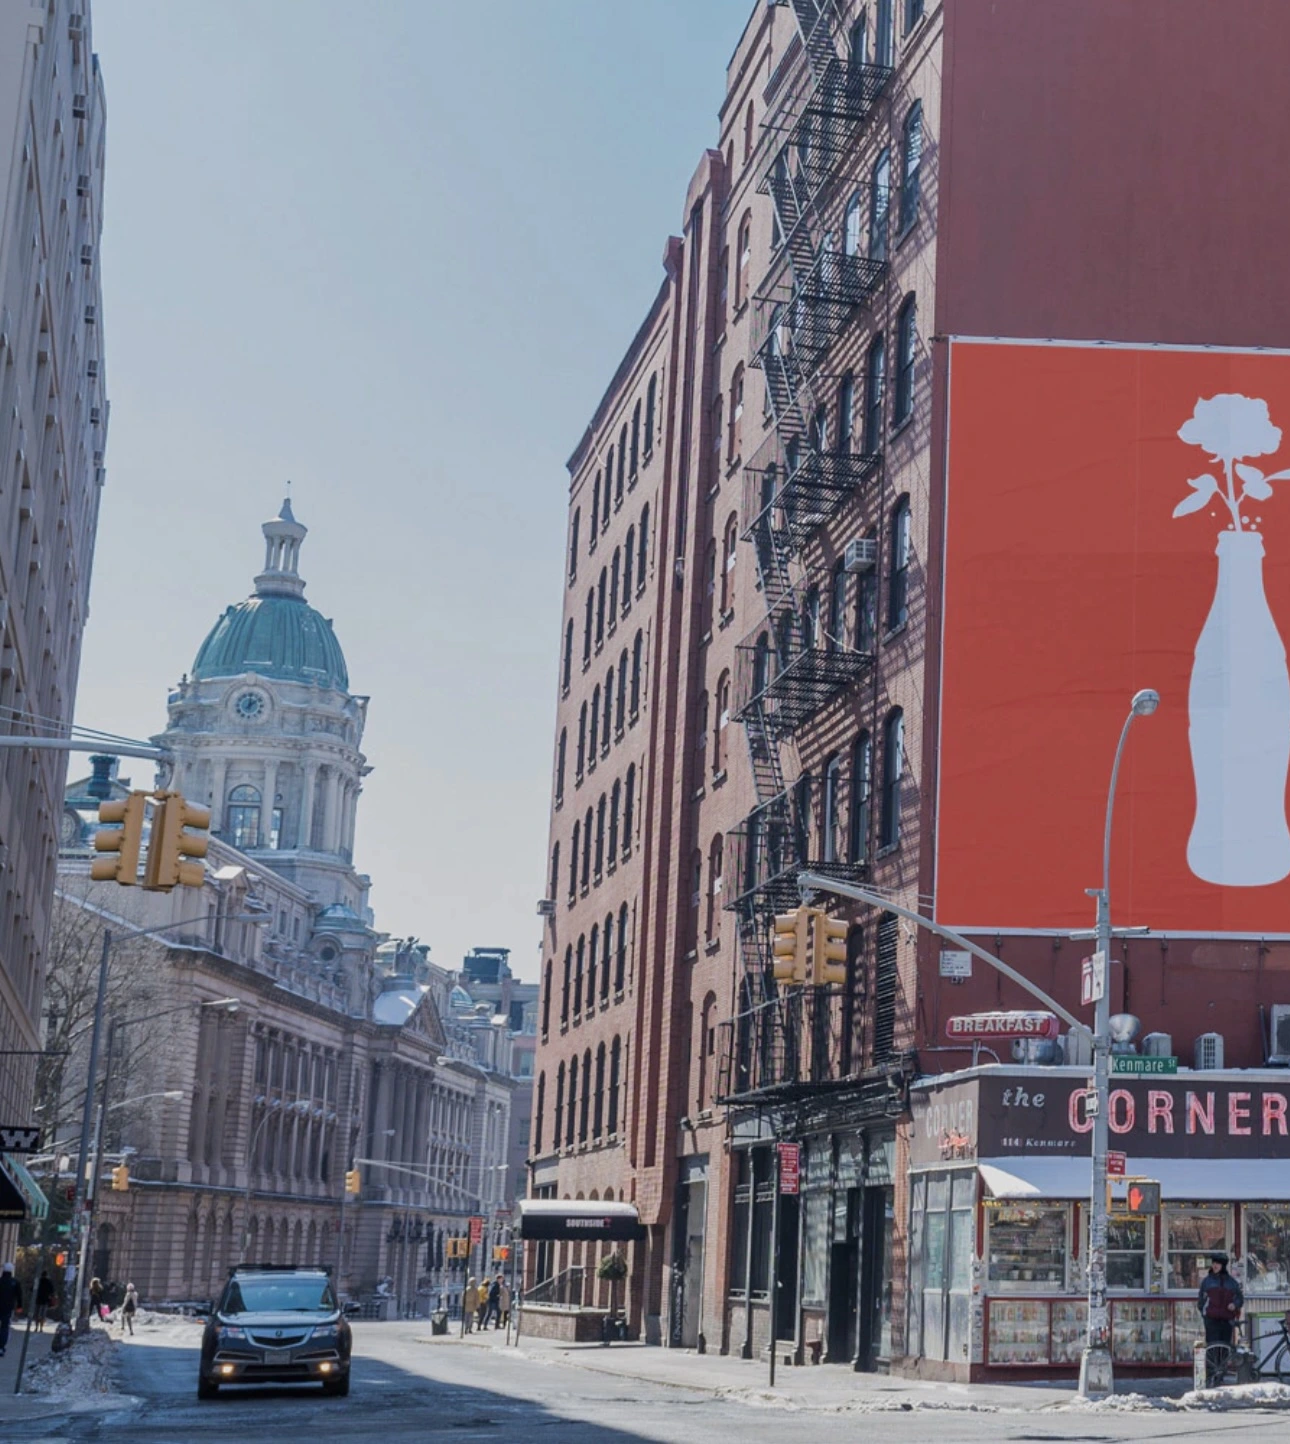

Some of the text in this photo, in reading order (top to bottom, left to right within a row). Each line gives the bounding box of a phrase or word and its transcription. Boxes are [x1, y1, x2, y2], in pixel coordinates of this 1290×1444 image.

[953, 1018, 1044, 1033] BREAKFAST
[1112, 1058, 1164, 1073] Kenmare
[926, 1098, 973, 1137] CORNER
[1002, 1086, 1289, 1136] the CORNER
